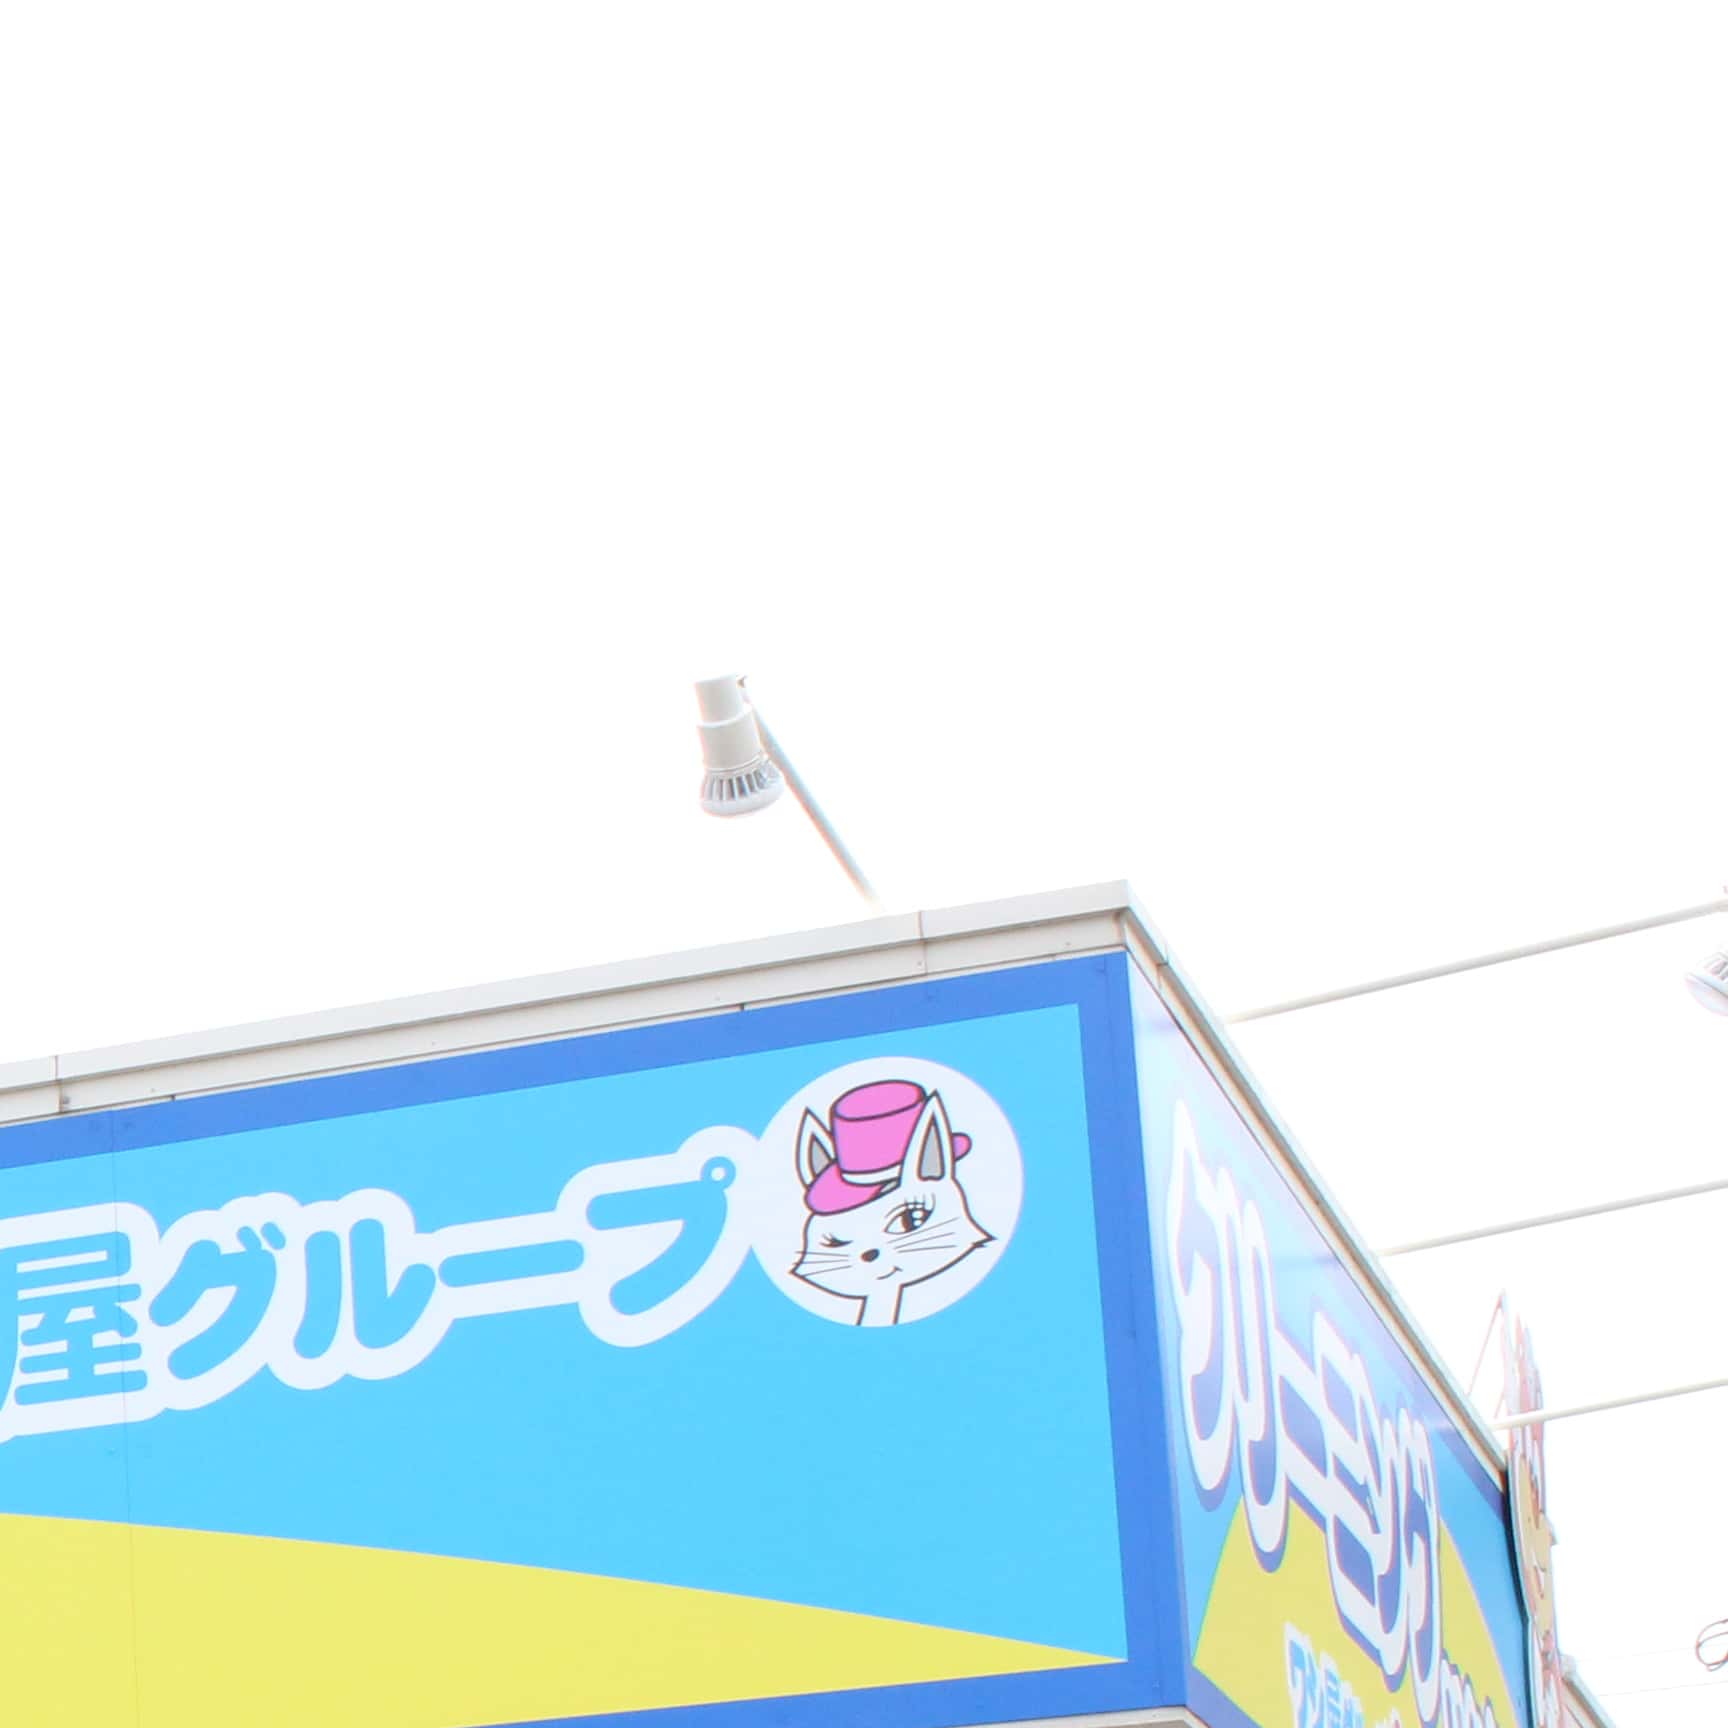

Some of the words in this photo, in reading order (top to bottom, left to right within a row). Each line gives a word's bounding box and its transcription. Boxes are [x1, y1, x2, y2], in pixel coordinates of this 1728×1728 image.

[1172, 1130, 1439, 1712] クリーニング
